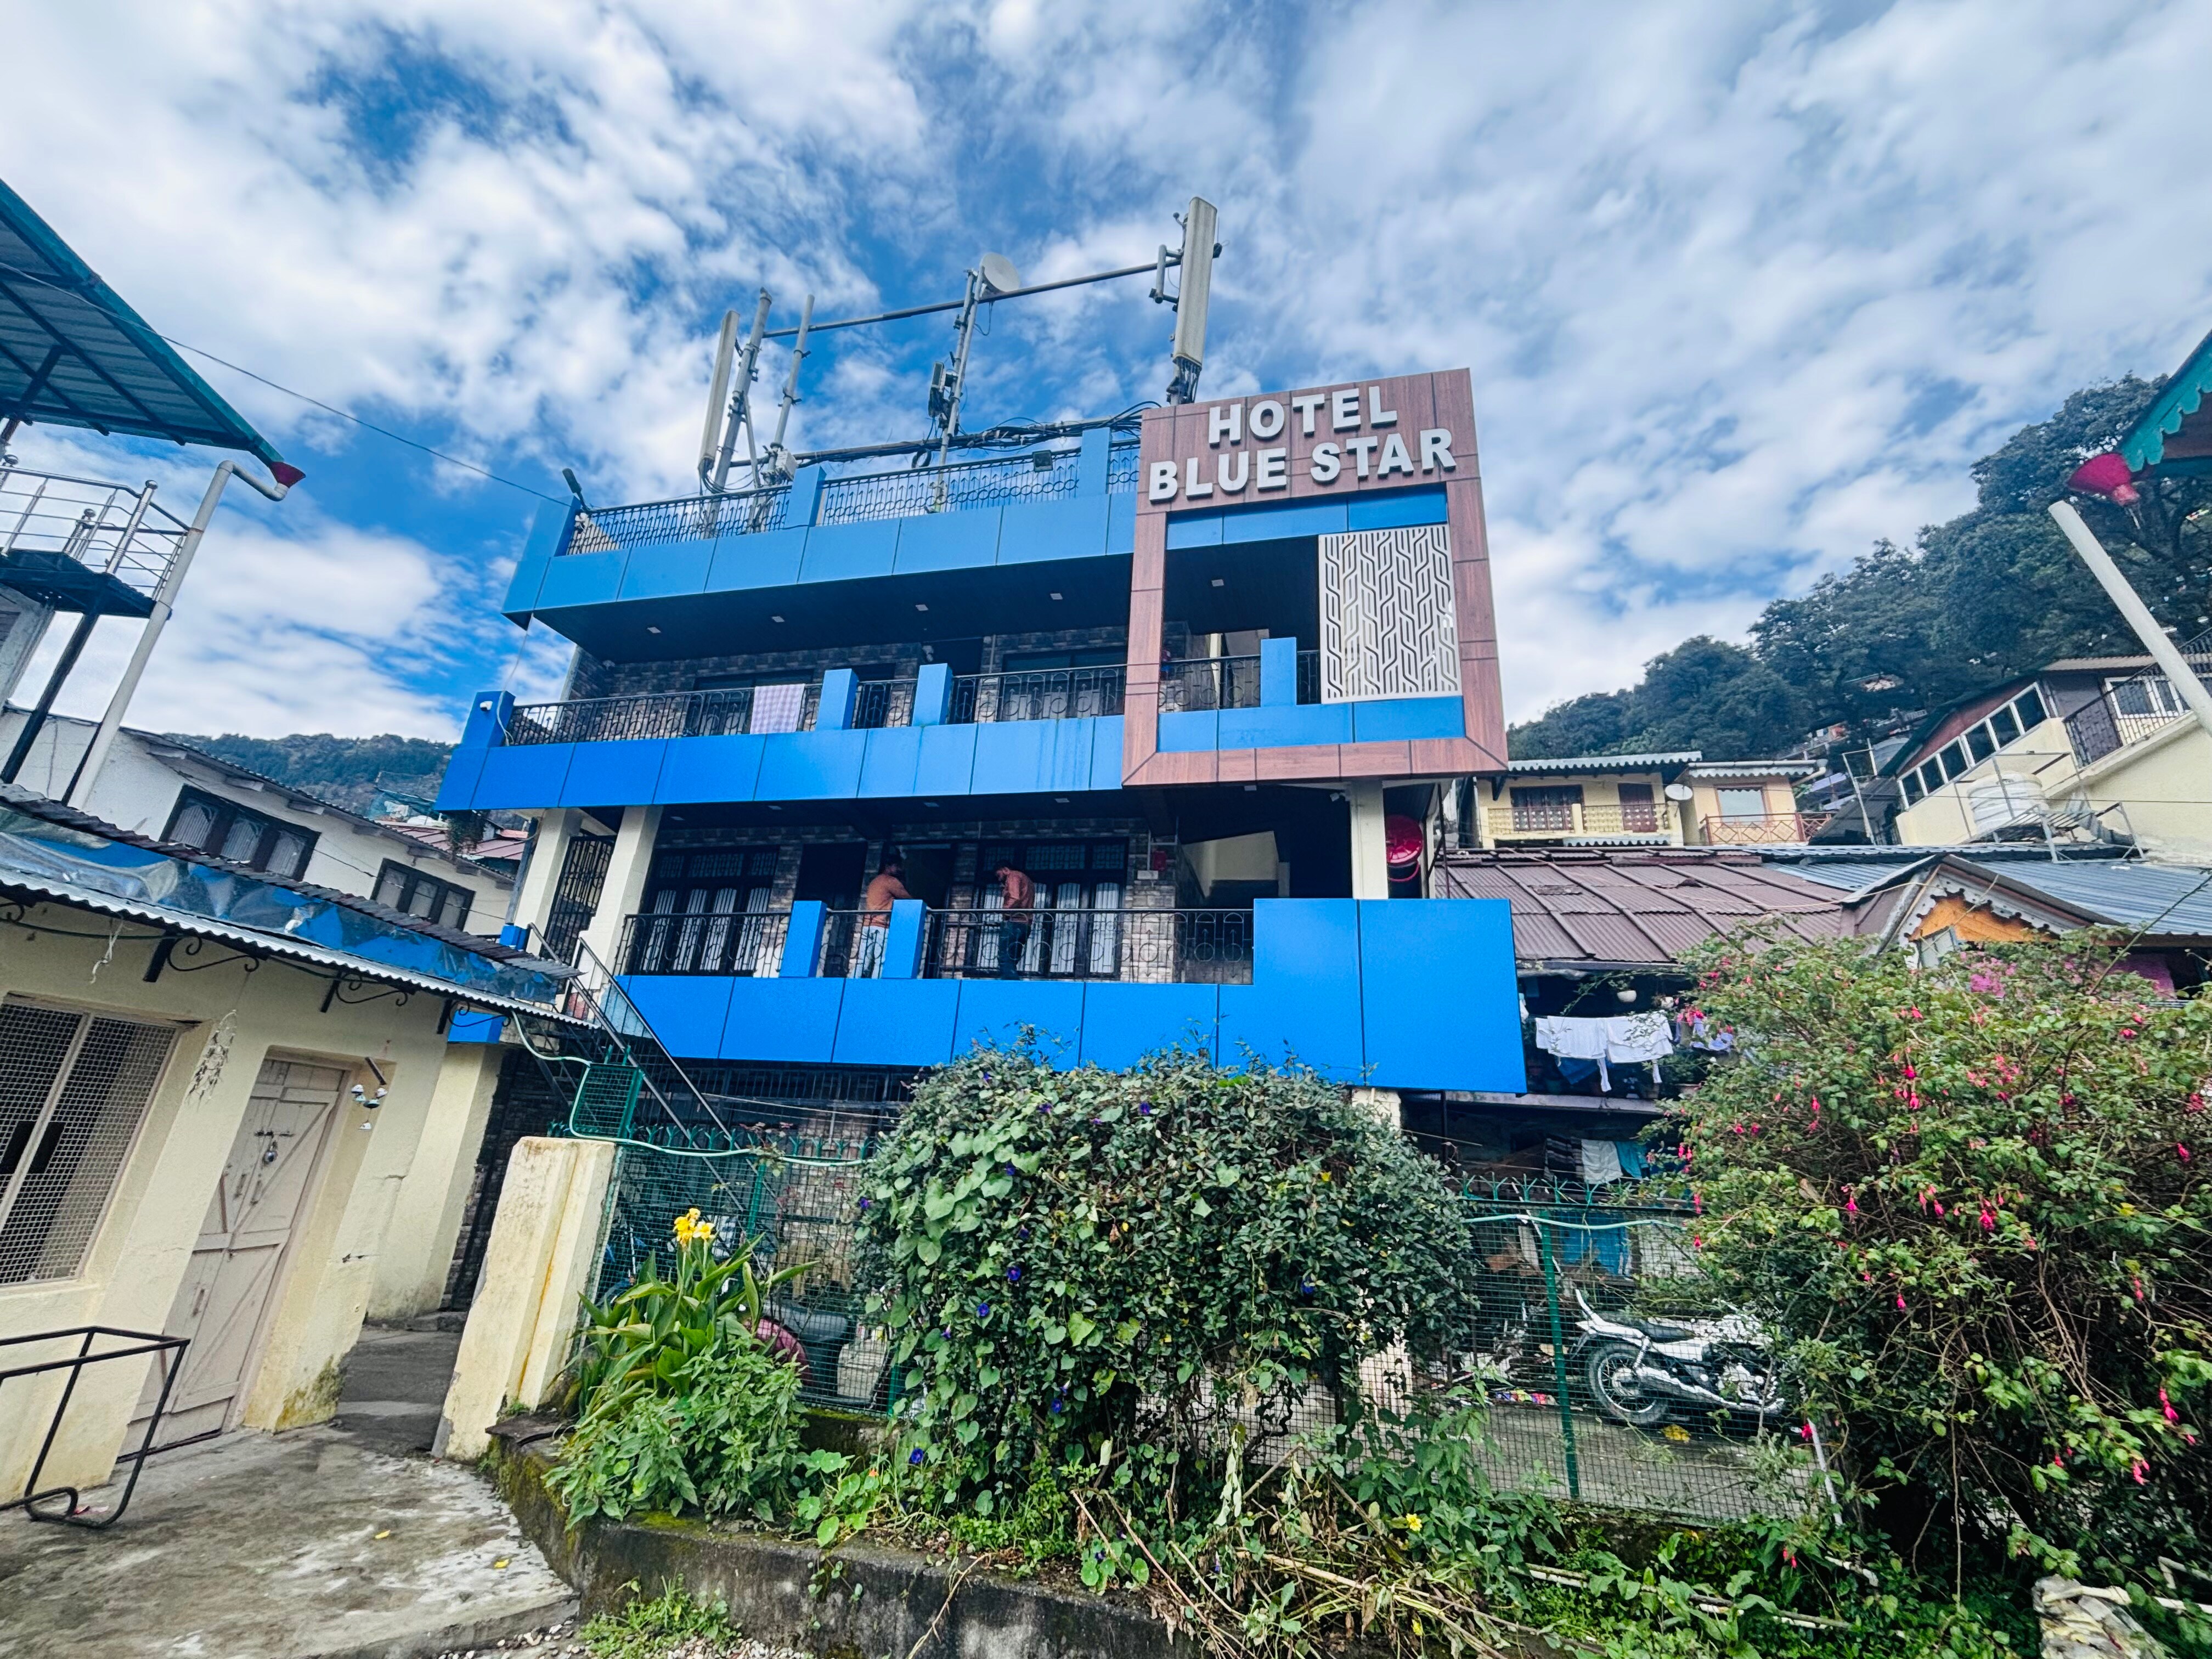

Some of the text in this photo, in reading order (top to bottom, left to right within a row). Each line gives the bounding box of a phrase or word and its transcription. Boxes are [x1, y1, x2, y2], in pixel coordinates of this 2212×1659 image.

[1209, 386, 1398, 446] HOTEL
[1149, 428, 1457, 501] BLUE STAR
